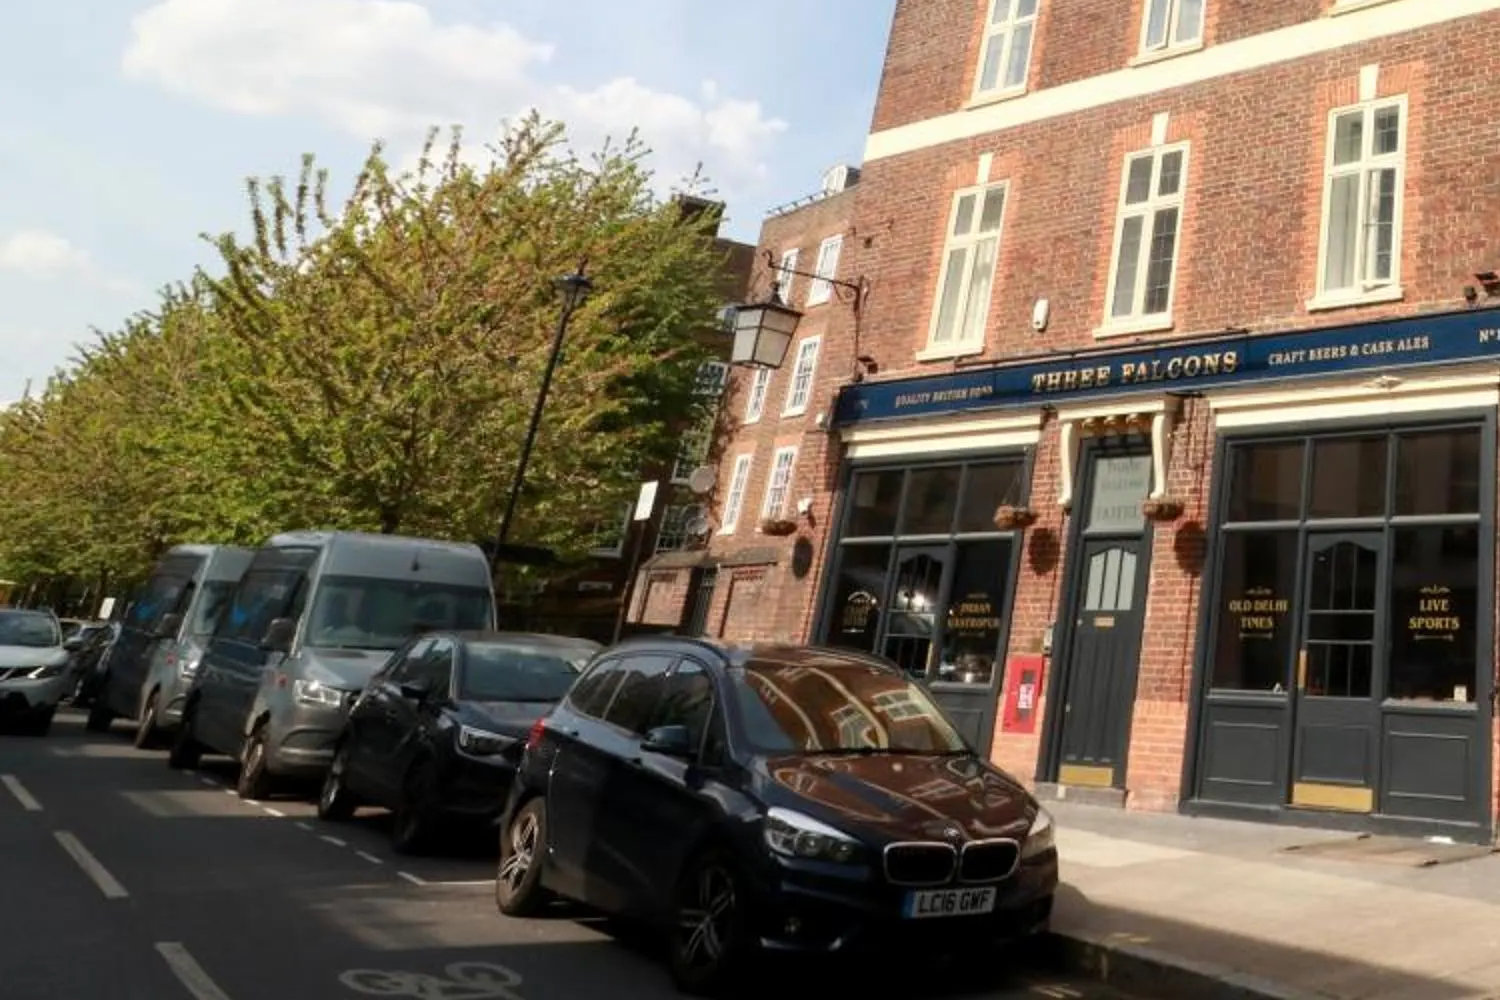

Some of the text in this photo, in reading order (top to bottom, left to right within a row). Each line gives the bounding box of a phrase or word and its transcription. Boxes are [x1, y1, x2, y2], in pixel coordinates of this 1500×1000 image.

[1267, 351, 1305, 366] CRAFT
[1309, 347, 1347, 361] BEERS
[1361, 340, 1394, 355] CASK
[1397, 335, 1430, 350] ALES
[1031, 351, 1237, 393] THREE FALCONS
[1229, 599, 1289, 613] OLD DELHI
[1419, 599, 1450, 612] LIVE
[1240, 616, 1274, 629] TIMES
[1408, 616, 1461, 630] SPORTS
